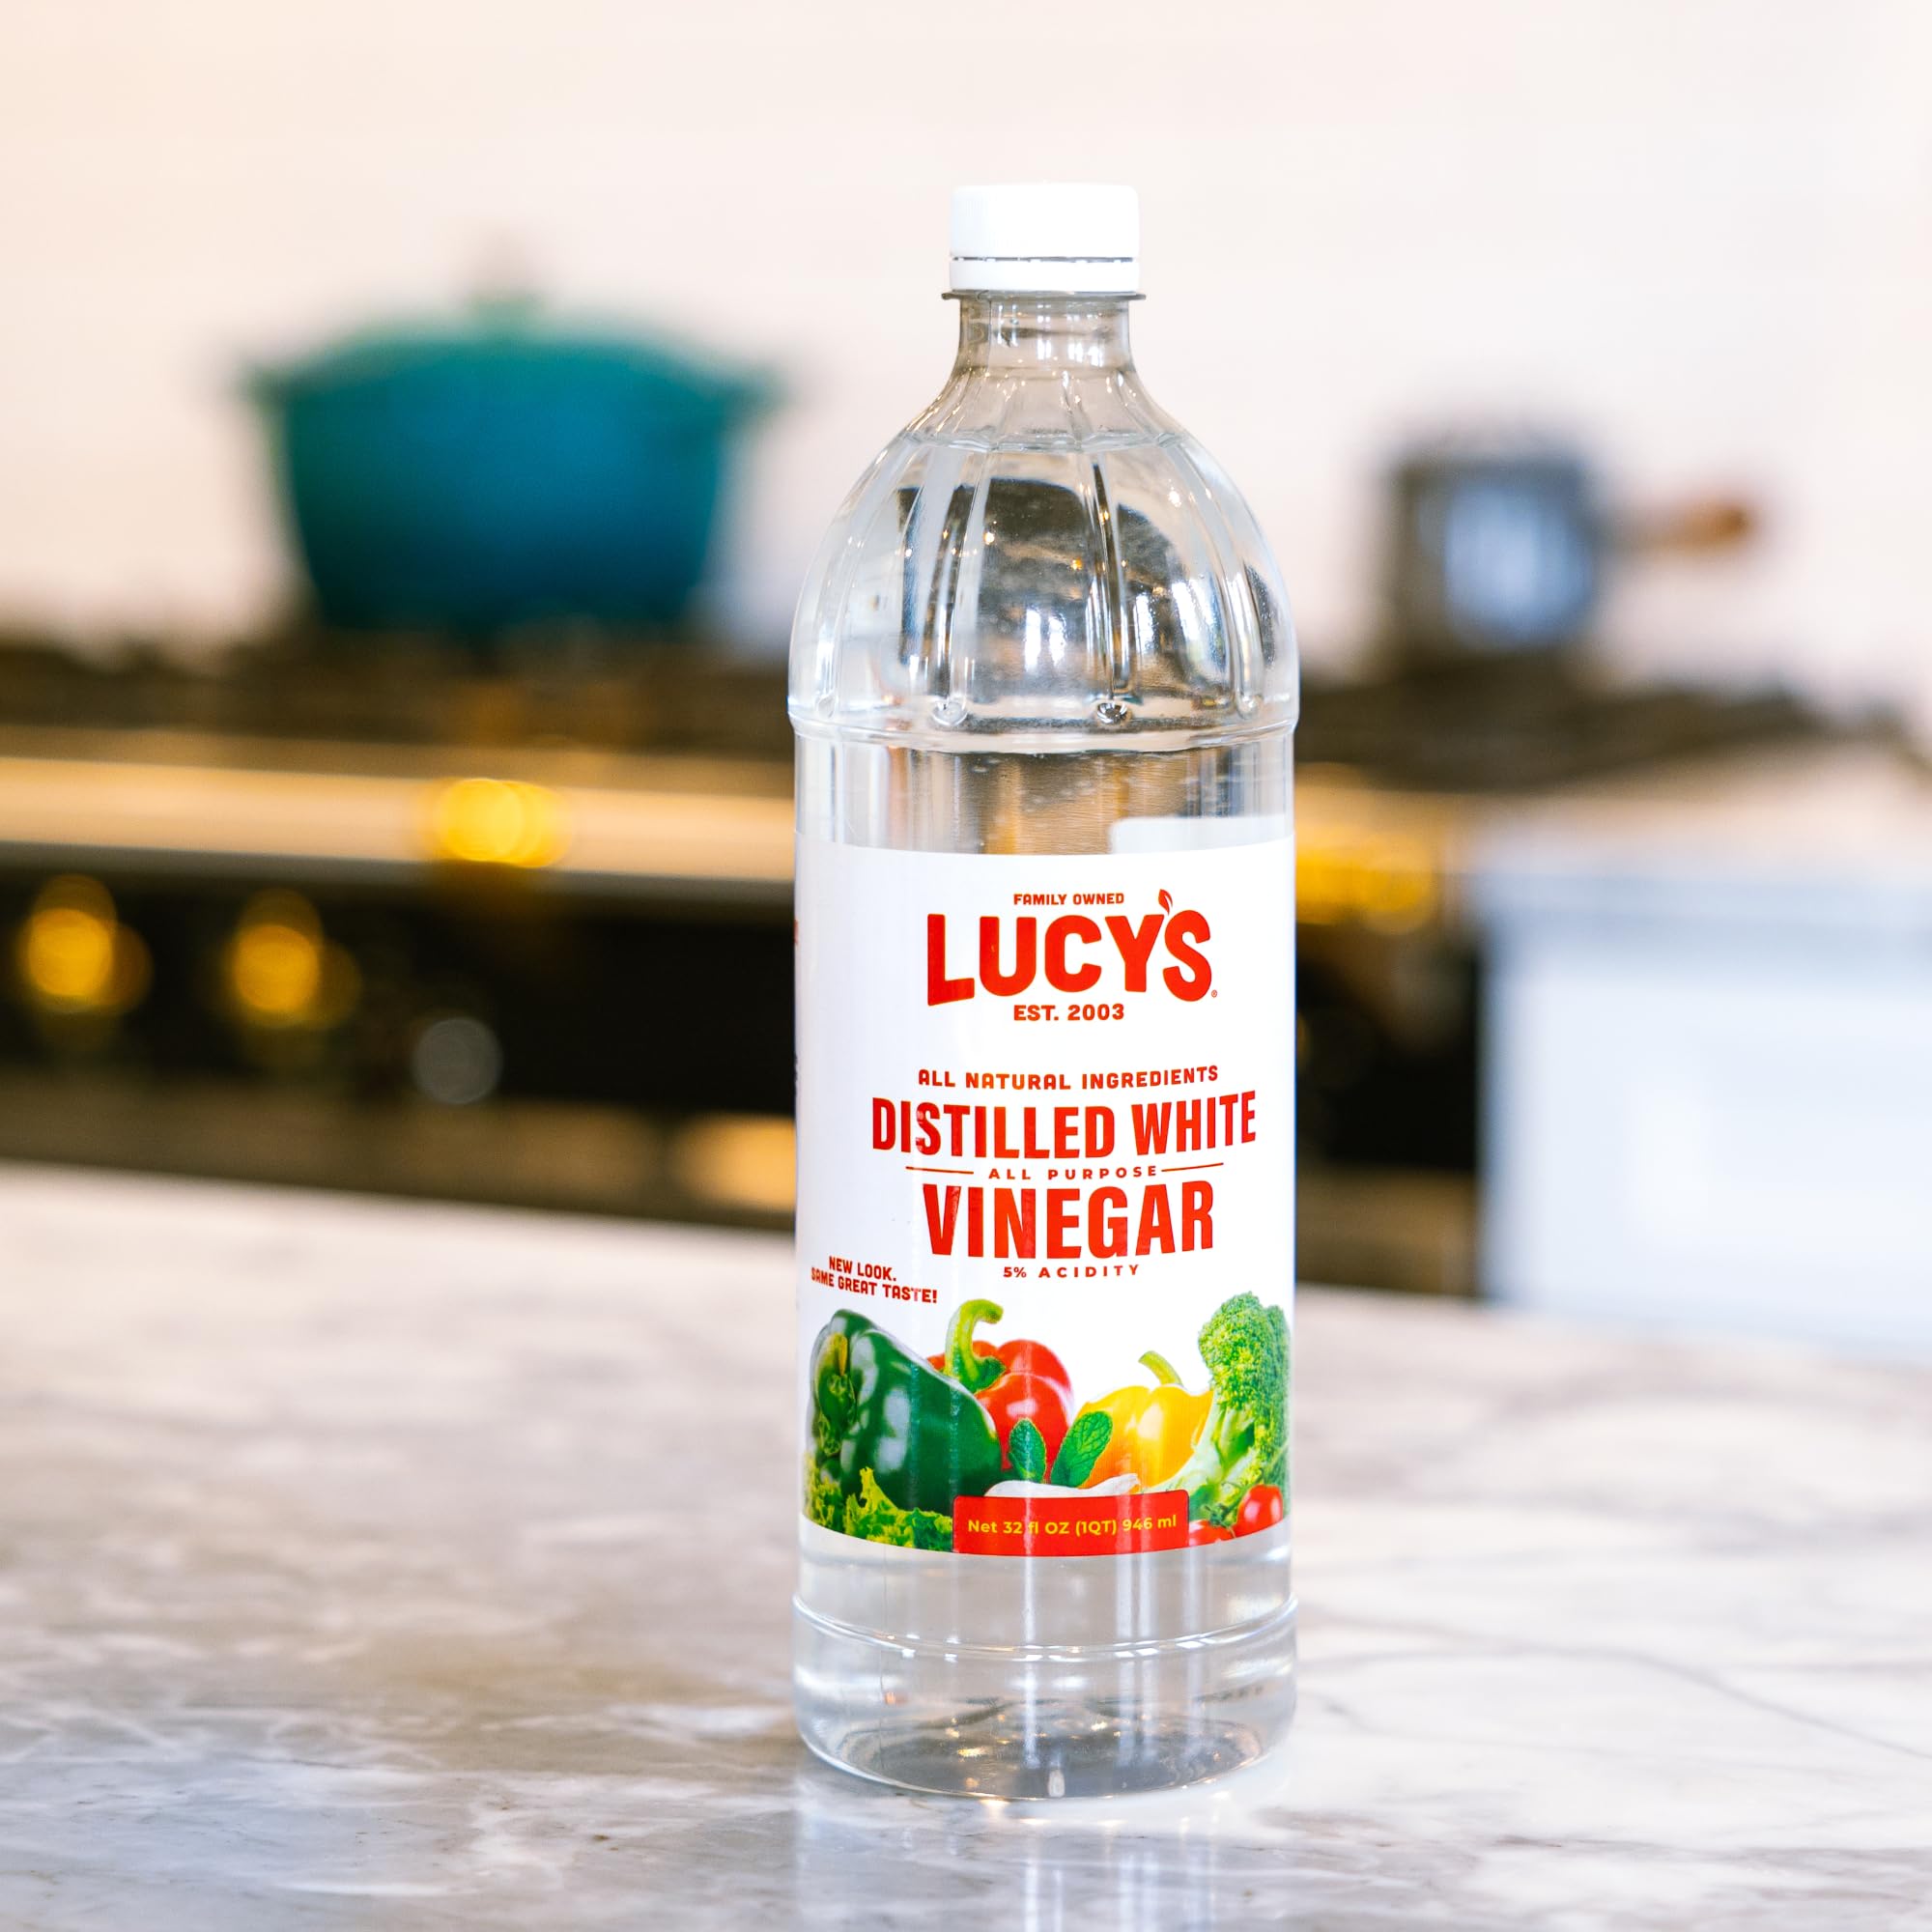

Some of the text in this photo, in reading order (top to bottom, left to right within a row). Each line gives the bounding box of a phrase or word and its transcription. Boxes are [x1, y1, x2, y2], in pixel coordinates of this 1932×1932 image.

[1013, 893, 1124, 906] FAMILY OWNED
[1013, 1004, 1125, 1021] EST. 2003
[918, 1065, 1218, 1091] ALL NATURAL INGREDIENTS
[872, 1090, 1256, 1159] DISTILLED WHITE
[988, 1165, 1156, 1180] ALL PURPOSE
[923, 1180, 1213, 1259] VINEGAR
[829, 1255, 896, 1282] NEW LOOK.
[1003, 1264, 1139, 1278] 5% ACIDITY
[810, 1266, 938, 1304] SAME GREAT TASTE!
[968, 1515, 1178, 1537] Net 32 fl OZ (1QT) 946 ml
